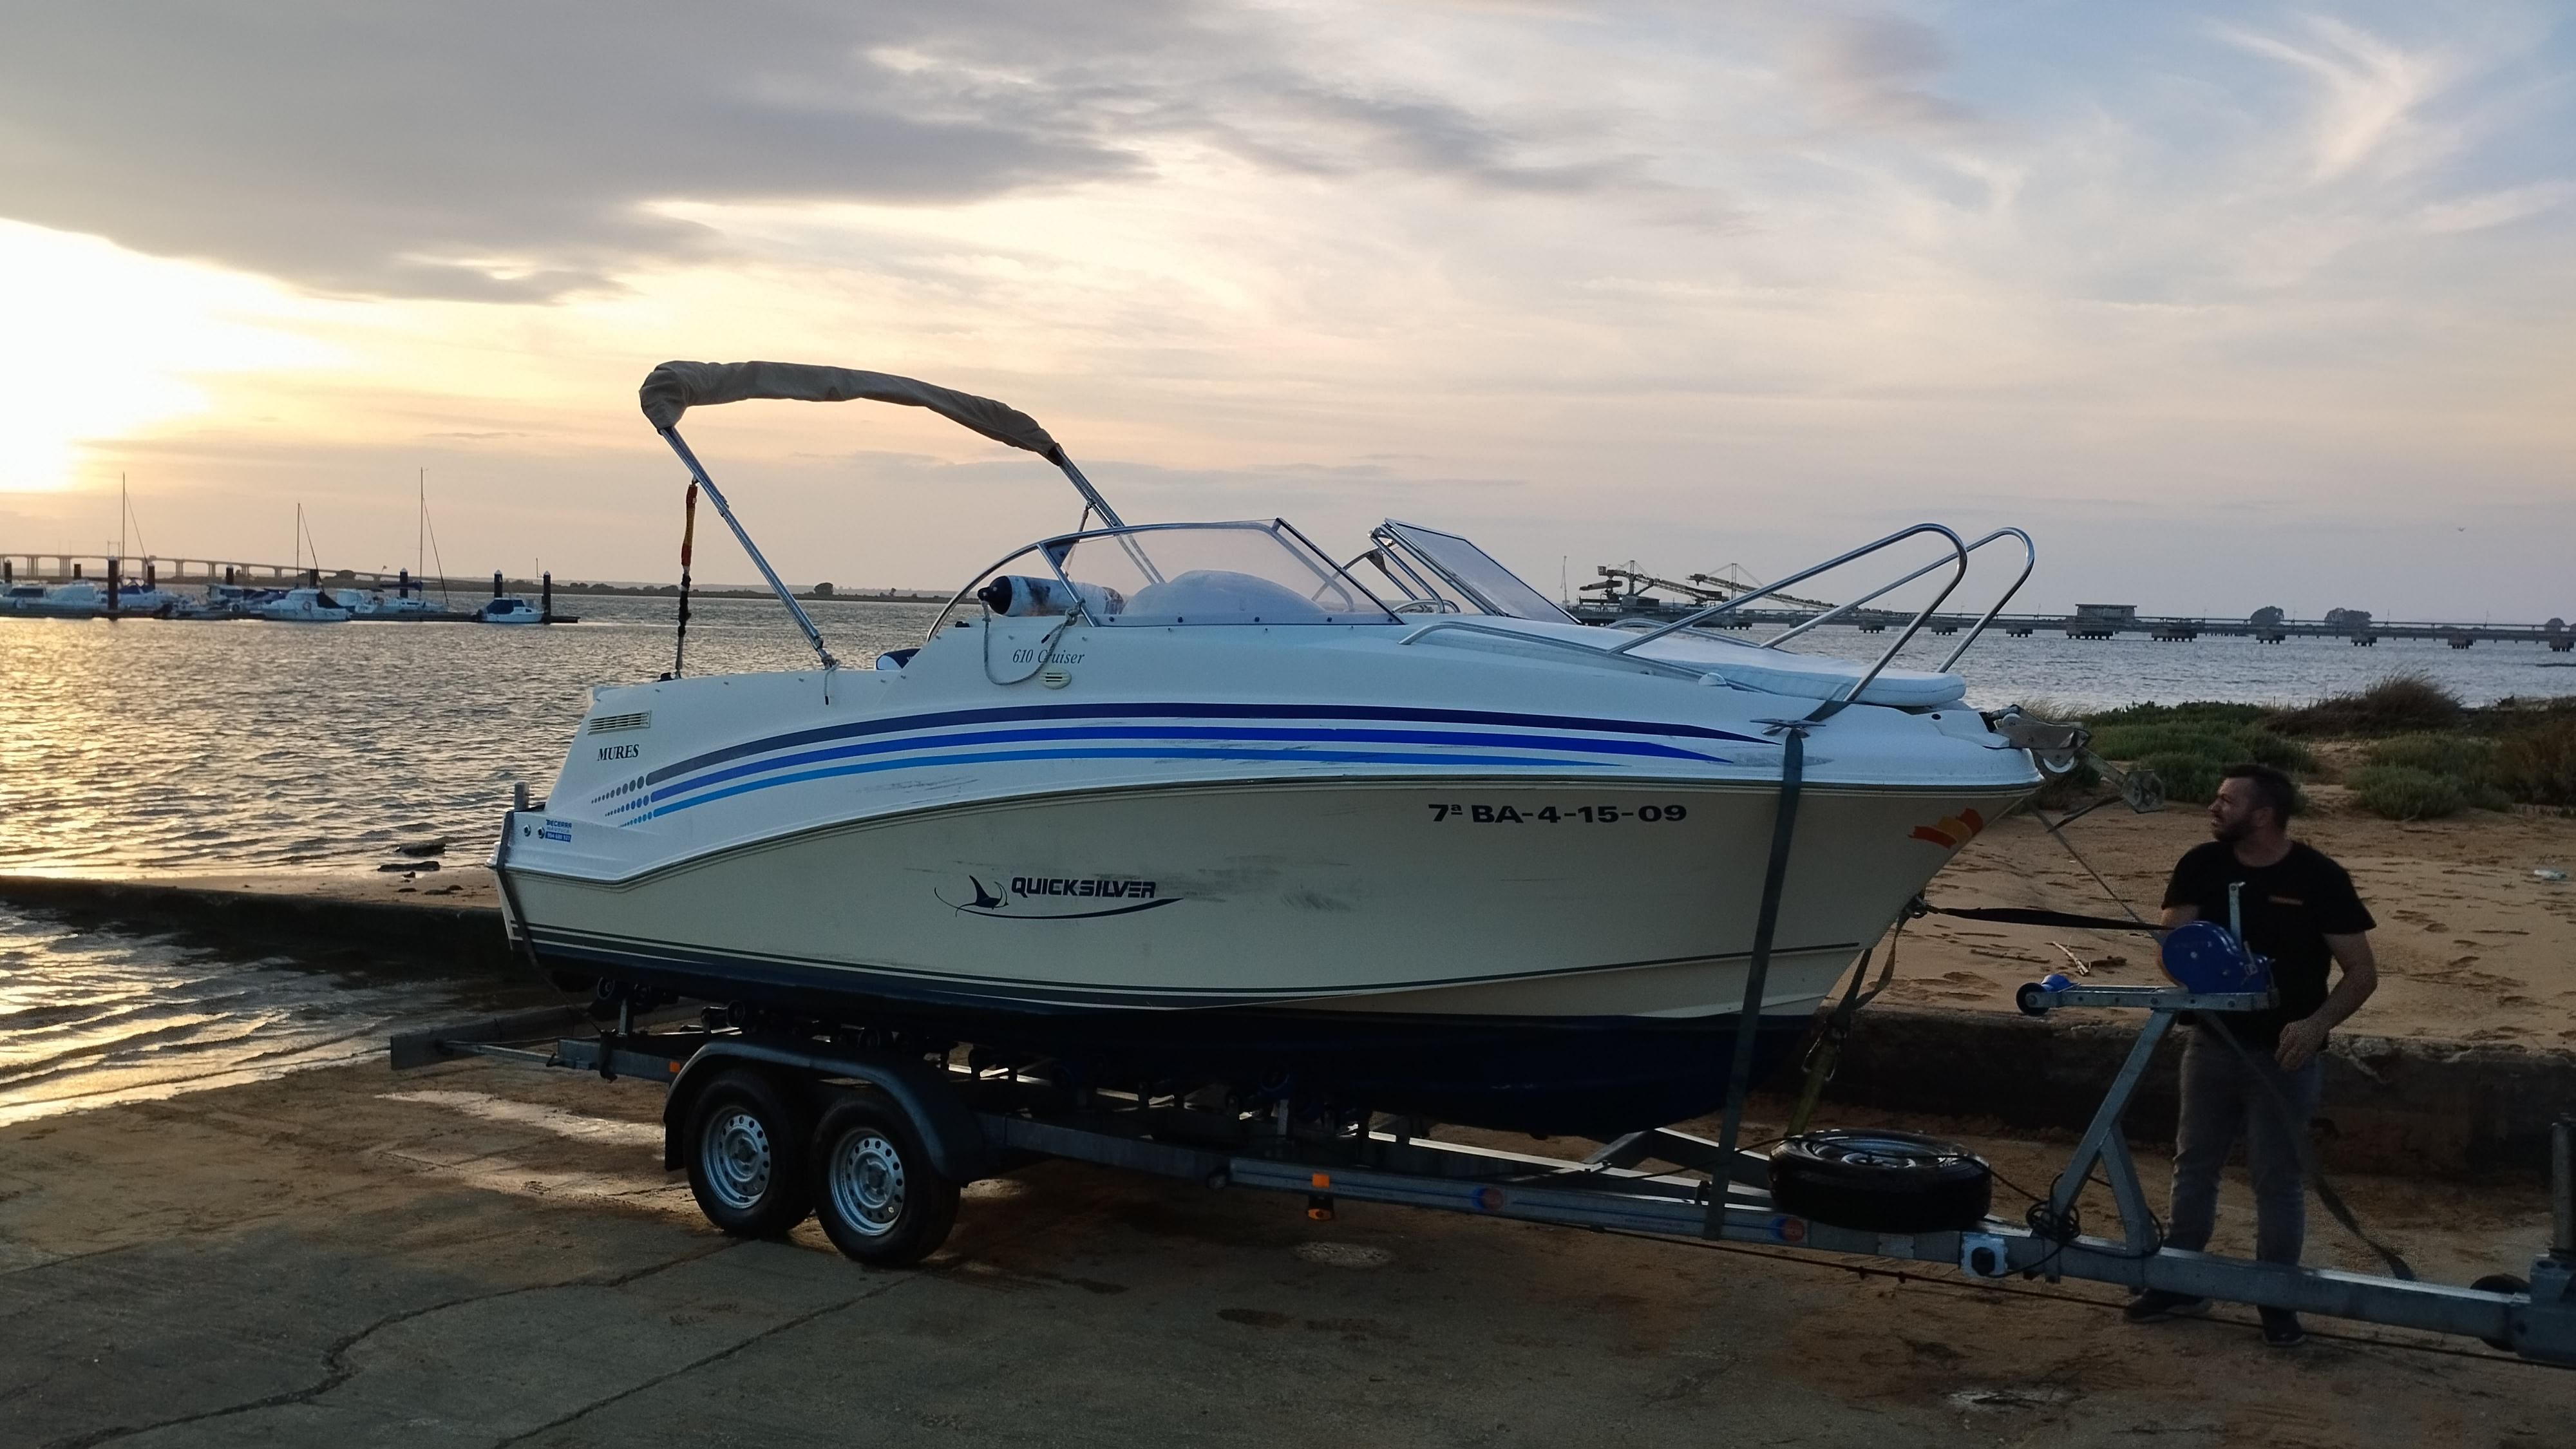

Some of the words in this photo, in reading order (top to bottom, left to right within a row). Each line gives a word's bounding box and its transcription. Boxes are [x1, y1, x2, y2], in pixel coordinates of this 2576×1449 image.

[1012, 649, 1034, 663] 610
[1037, 649, 1085, 664] Cuiser
[597, 744, 639, 761] MURES
[1471, 804, 1687, 824] BA-4-15-09
[1011, 876, 1157, 899] QUICKSILVER
